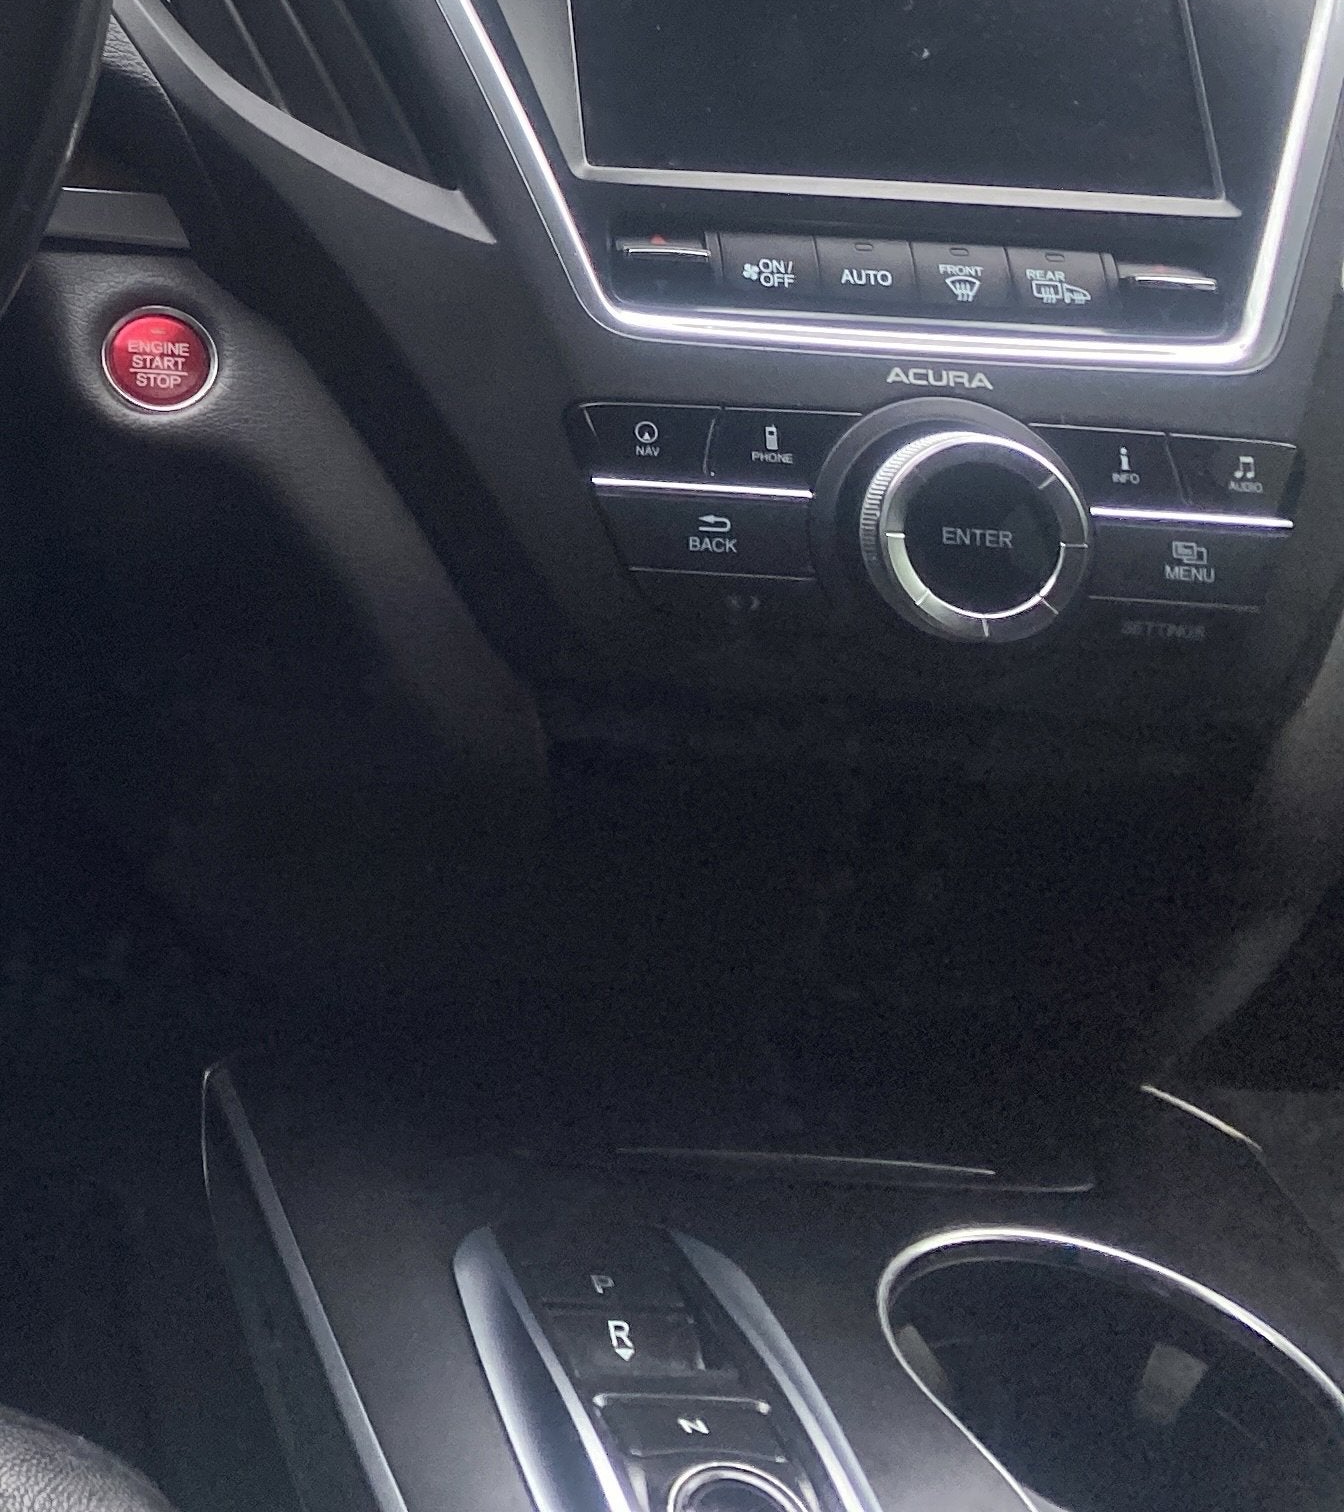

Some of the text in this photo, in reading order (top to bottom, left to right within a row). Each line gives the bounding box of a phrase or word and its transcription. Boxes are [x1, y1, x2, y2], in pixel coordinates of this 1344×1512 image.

[841, 268, 893, 287] AUTO
[938, 263, 984, 277] FRONT
[1025, 268, 1066, 282] REAR
[759, 272, 796, 289] OFF
[127, 340, 190, 356] ENGINE
[130, 354, 186, 371] START
[135, 373, 182, 389] STOP
[886, 366, 994, 391] ACURA
[635, 445, 660, 457] NAV
[750, 450, 794, 465] PHONE
[1111, 472, 1141, 485] INFO
[1228, 480, 1263, 494] AUDIO
[688, 536, 738, 554] BACK
[941, 526, 1013, 549] ENTER
[1165, 564, 1216, 583] MENU
[590, 1274, 615, 1294] P
[607, 1319, 635, 1350] R
[676, 1416, 711, 1435] N
